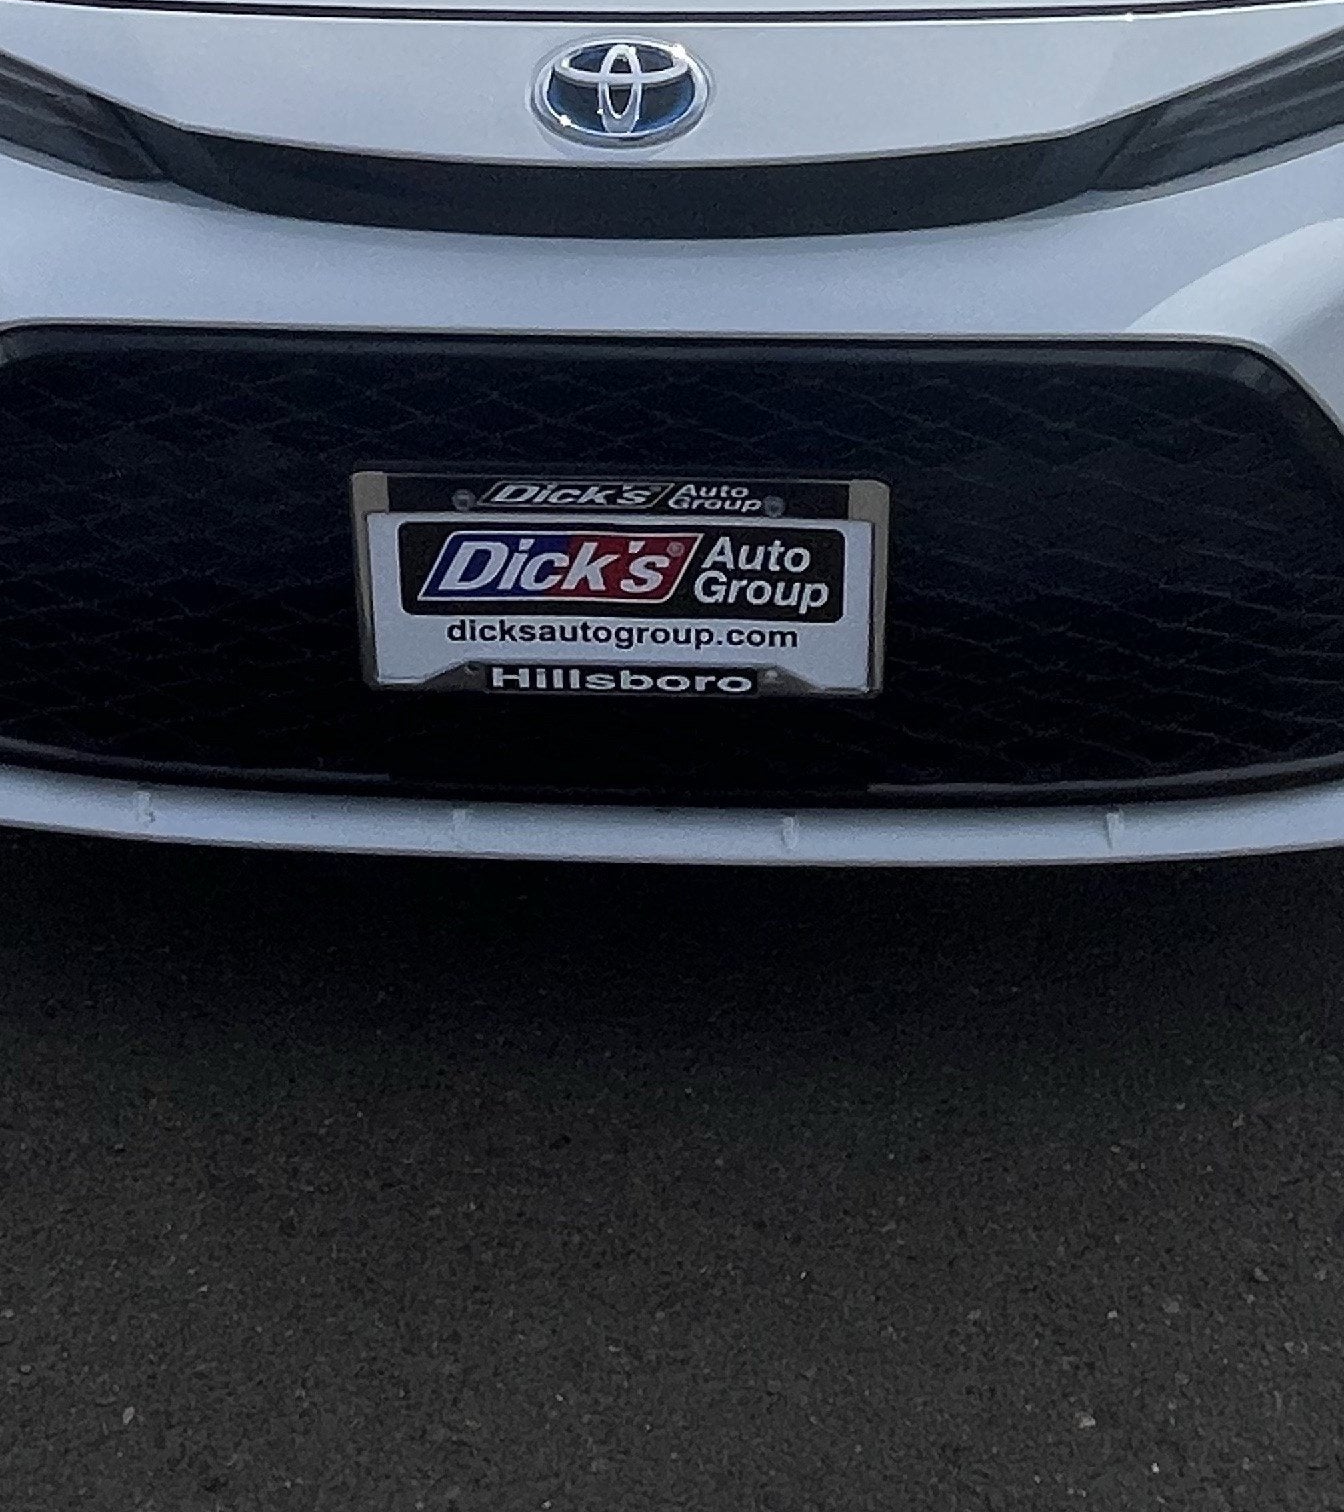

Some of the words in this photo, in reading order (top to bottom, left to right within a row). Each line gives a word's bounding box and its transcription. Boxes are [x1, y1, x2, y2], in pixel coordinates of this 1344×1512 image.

[668, 496, 762, 512] Group
[676, 484, 749, 498] Auto
[701, 536, 811, 574] Auto
[693, 571, 829, 614] Group
[446, 618, 799, 650] dicksautogroup.com
[491, 666, 753, 692] Hillsboro
